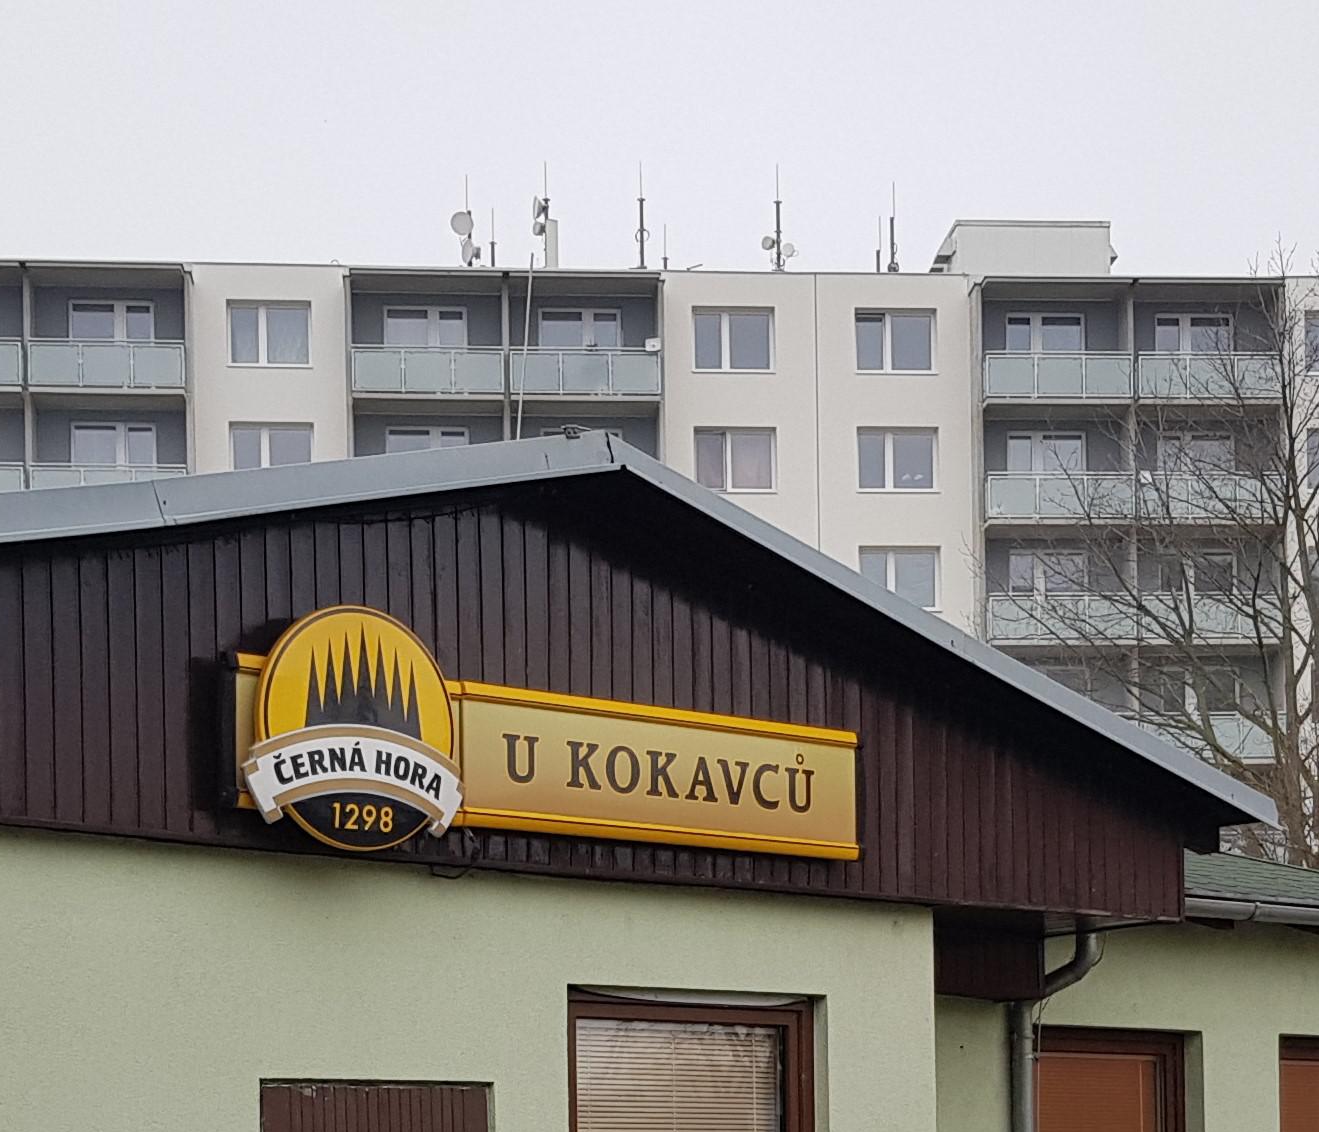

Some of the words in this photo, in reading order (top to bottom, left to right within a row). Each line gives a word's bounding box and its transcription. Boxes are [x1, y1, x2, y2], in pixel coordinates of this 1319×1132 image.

[273, 741, 367, 785] ČERNÁ
[375, 749, 442, 800] HORA
[502, 733, 539, 783] U
[566, 740, 815, 813] KOKAVCŮ
[332, 802, 393, 833] 1298
